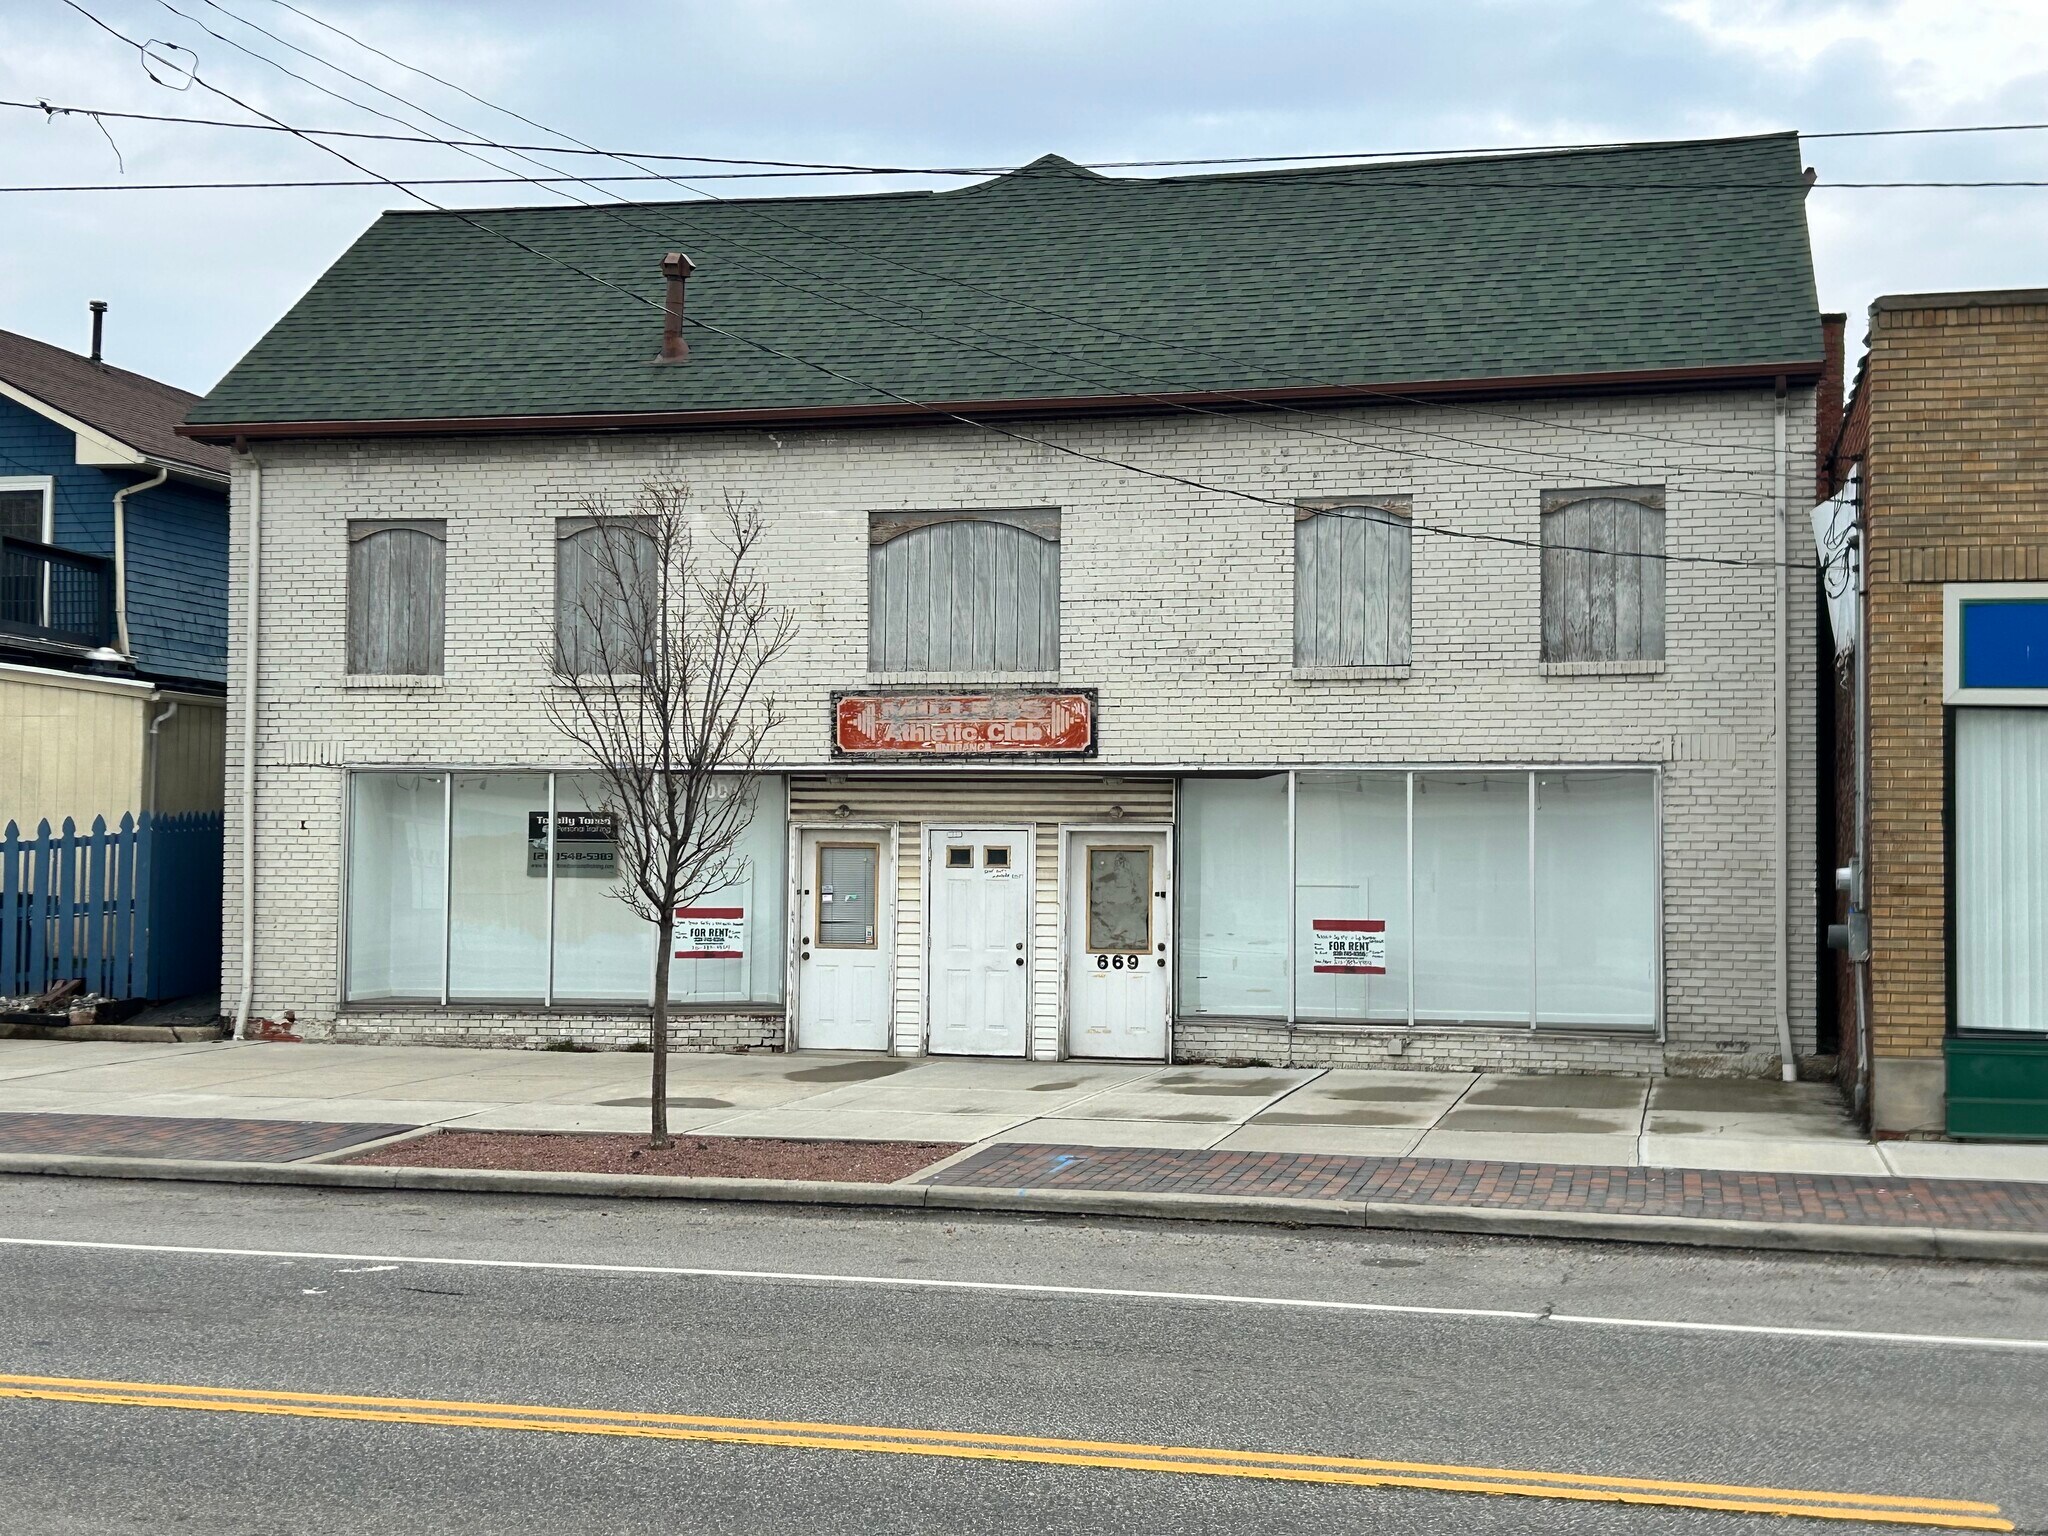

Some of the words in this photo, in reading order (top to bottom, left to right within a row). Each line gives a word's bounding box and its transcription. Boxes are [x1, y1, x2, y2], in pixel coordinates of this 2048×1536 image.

[884, 722, 979, 742] Athletic
[987, 722, 1043, 742] Club
[690, 928, 706, 937] FOR
[708, 928, 729, 937] RENT
[1329, 942, 1345, 950] FOR
[1348, 942, 1369, 951] RENT
[1097, 954, 1139, 970] 669
